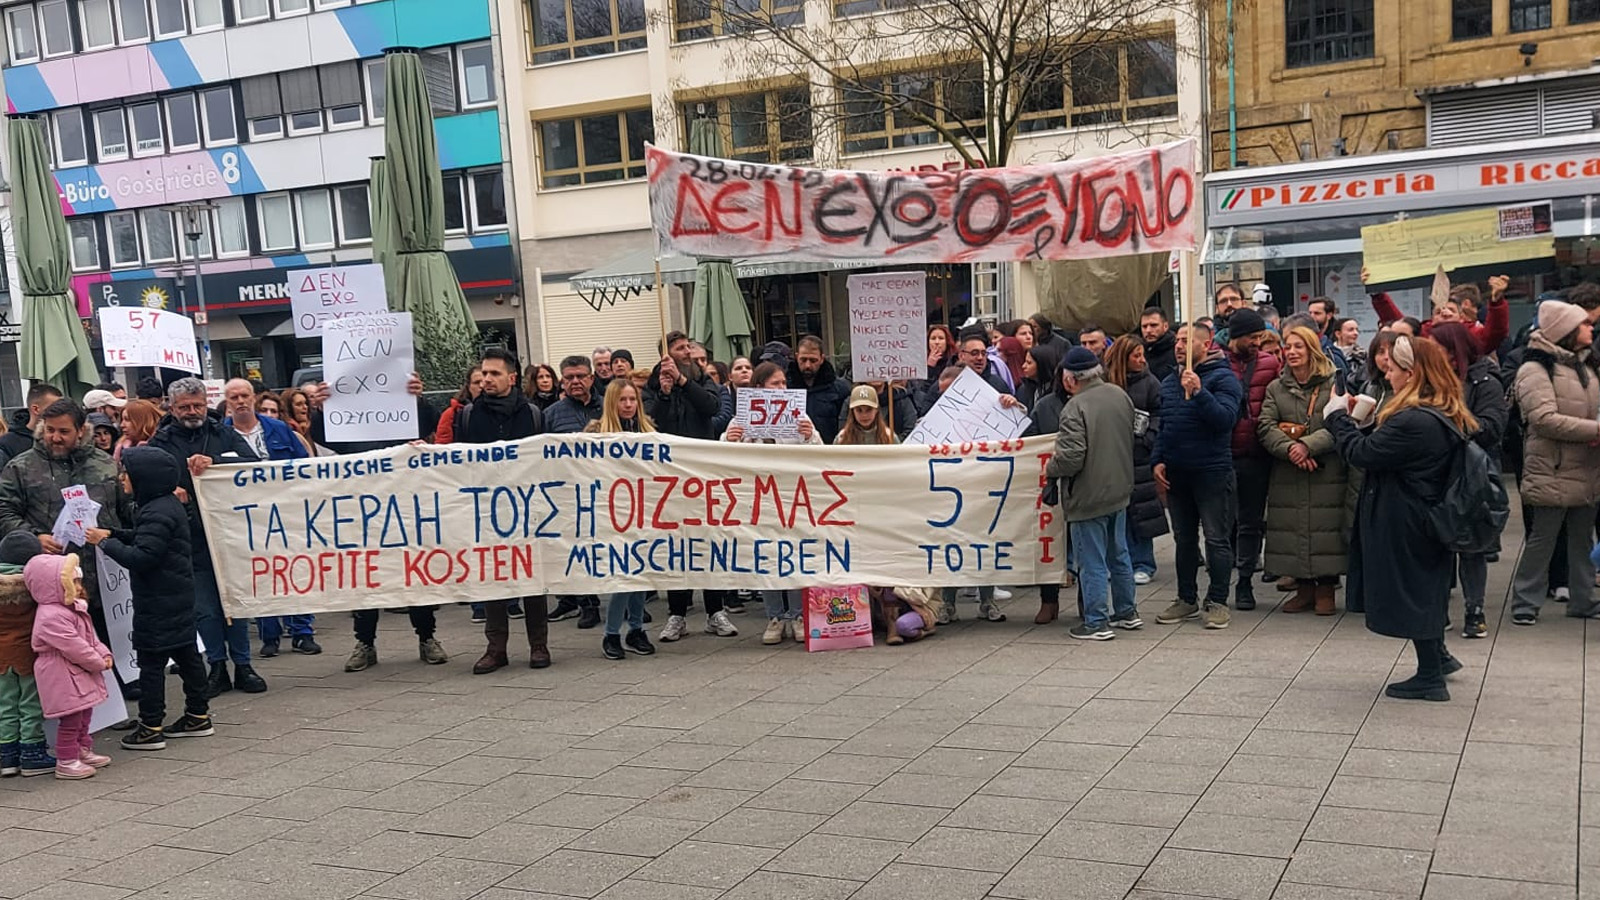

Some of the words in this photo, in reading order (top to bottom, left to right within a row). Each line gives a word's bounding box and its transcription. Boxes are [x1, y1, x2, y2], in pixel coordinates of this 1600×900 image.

[116, 165, 217, 197] Goseriede
[222, 152, 240, 184] 8
[1250, 173, 1435, 207] Pizzeria
[300, 272, 346, 293] ΔΕΝ
[128, 311, 160, 330] 57
[336, 338, 393, 362] ΔΕΝ
[233, 457, 393, 487] GRIECHISCHE
[408, 444, 519, 469] GEMEINDE
[543, 442, 673, 463] HANNOVER
[233, 503, 288, 550] ΤΑ
[304, 491, 441, 550] ΚΕΡΔΗ
[459, 481, 566, 543] ΤΟΥΣ
[751, 470, 855, 529] ΜΑΣ
[927, 456, 1015, 535] 57
[251, 550, 381, 598] PROFITE
[404, 543, 533, 587] KOSTEN
[565, 533, 850, 577] MENSCHENLEBEN
[918, 541, 1014, 574] TOTE
